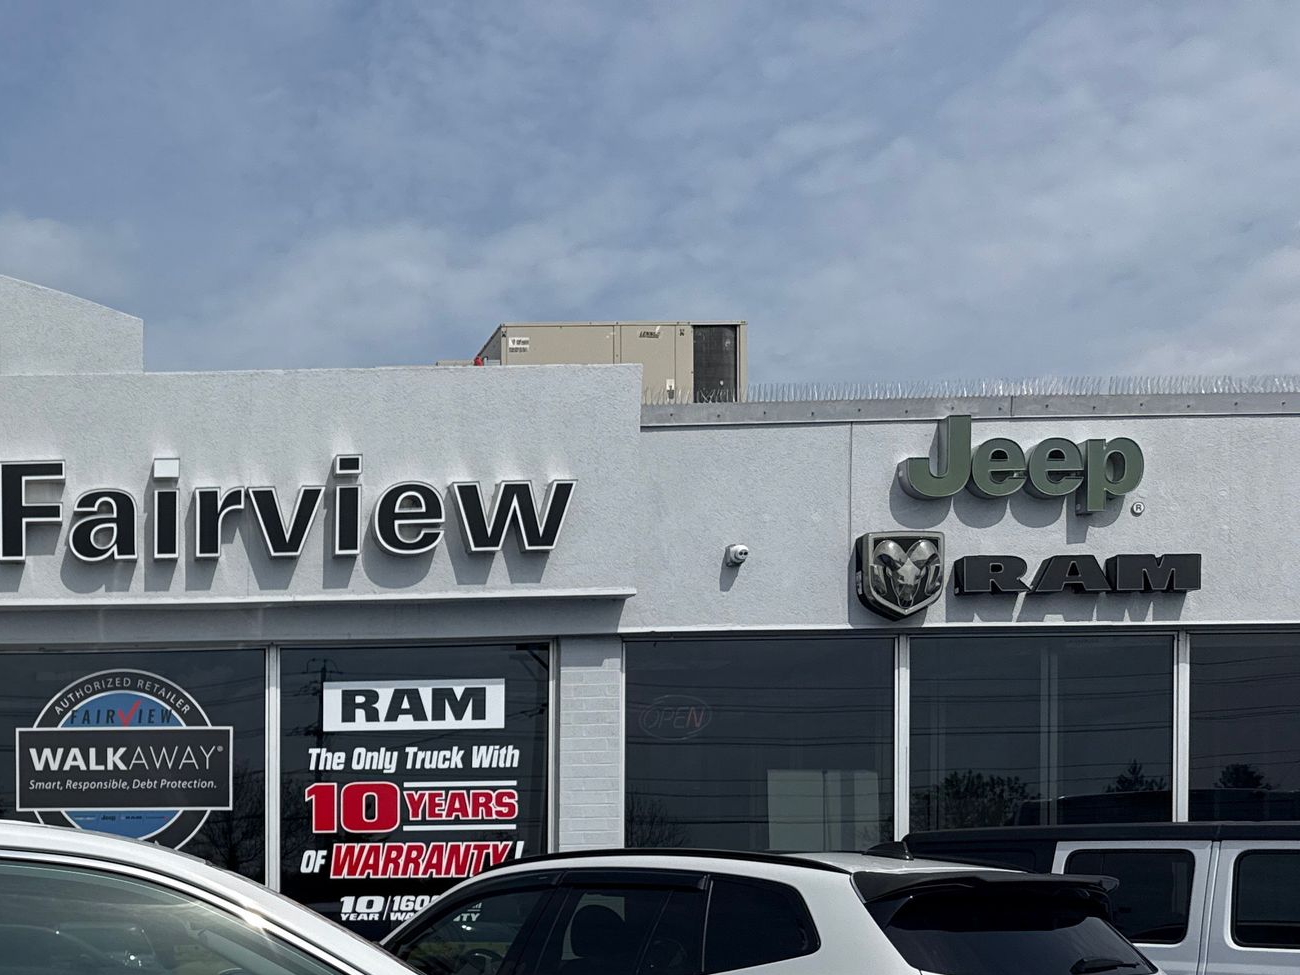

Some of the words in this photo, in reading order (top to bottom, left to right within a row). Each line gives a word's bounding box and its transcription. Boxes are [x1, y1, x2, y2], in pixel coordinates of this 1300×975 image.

[898, 415, 1144, 514] Jeep
[954, 553, 1202, 596] RAM
[54, 677, 131, 716] AUTHORIZED
[137, 679, 191, 715] RETAILER
[341, 687, 486, 723] RAM
[70, 699, 173, 727] FAIRVIEW
[643, 706, 706, 729] OPEN
[308, 748, 345, 771] The
[351, 747, 398, 774] Only
[404, 746, 464, 770] Truck
[471, 744, 520, 768] With
[29, 779, 63, 790] Smart,
[66, 779, 130, 791] Responsible,
[132, 779, 158, 789] Debt
[160, 778, 217, 789] Protection.
[304, 781, 400, 834] 10
[404, 789, 518, 821] YEARS
[300, 850, 327, 873] OF
[340, 895, 385, 913] 10
[340, 913, 380, 921] YEAR
